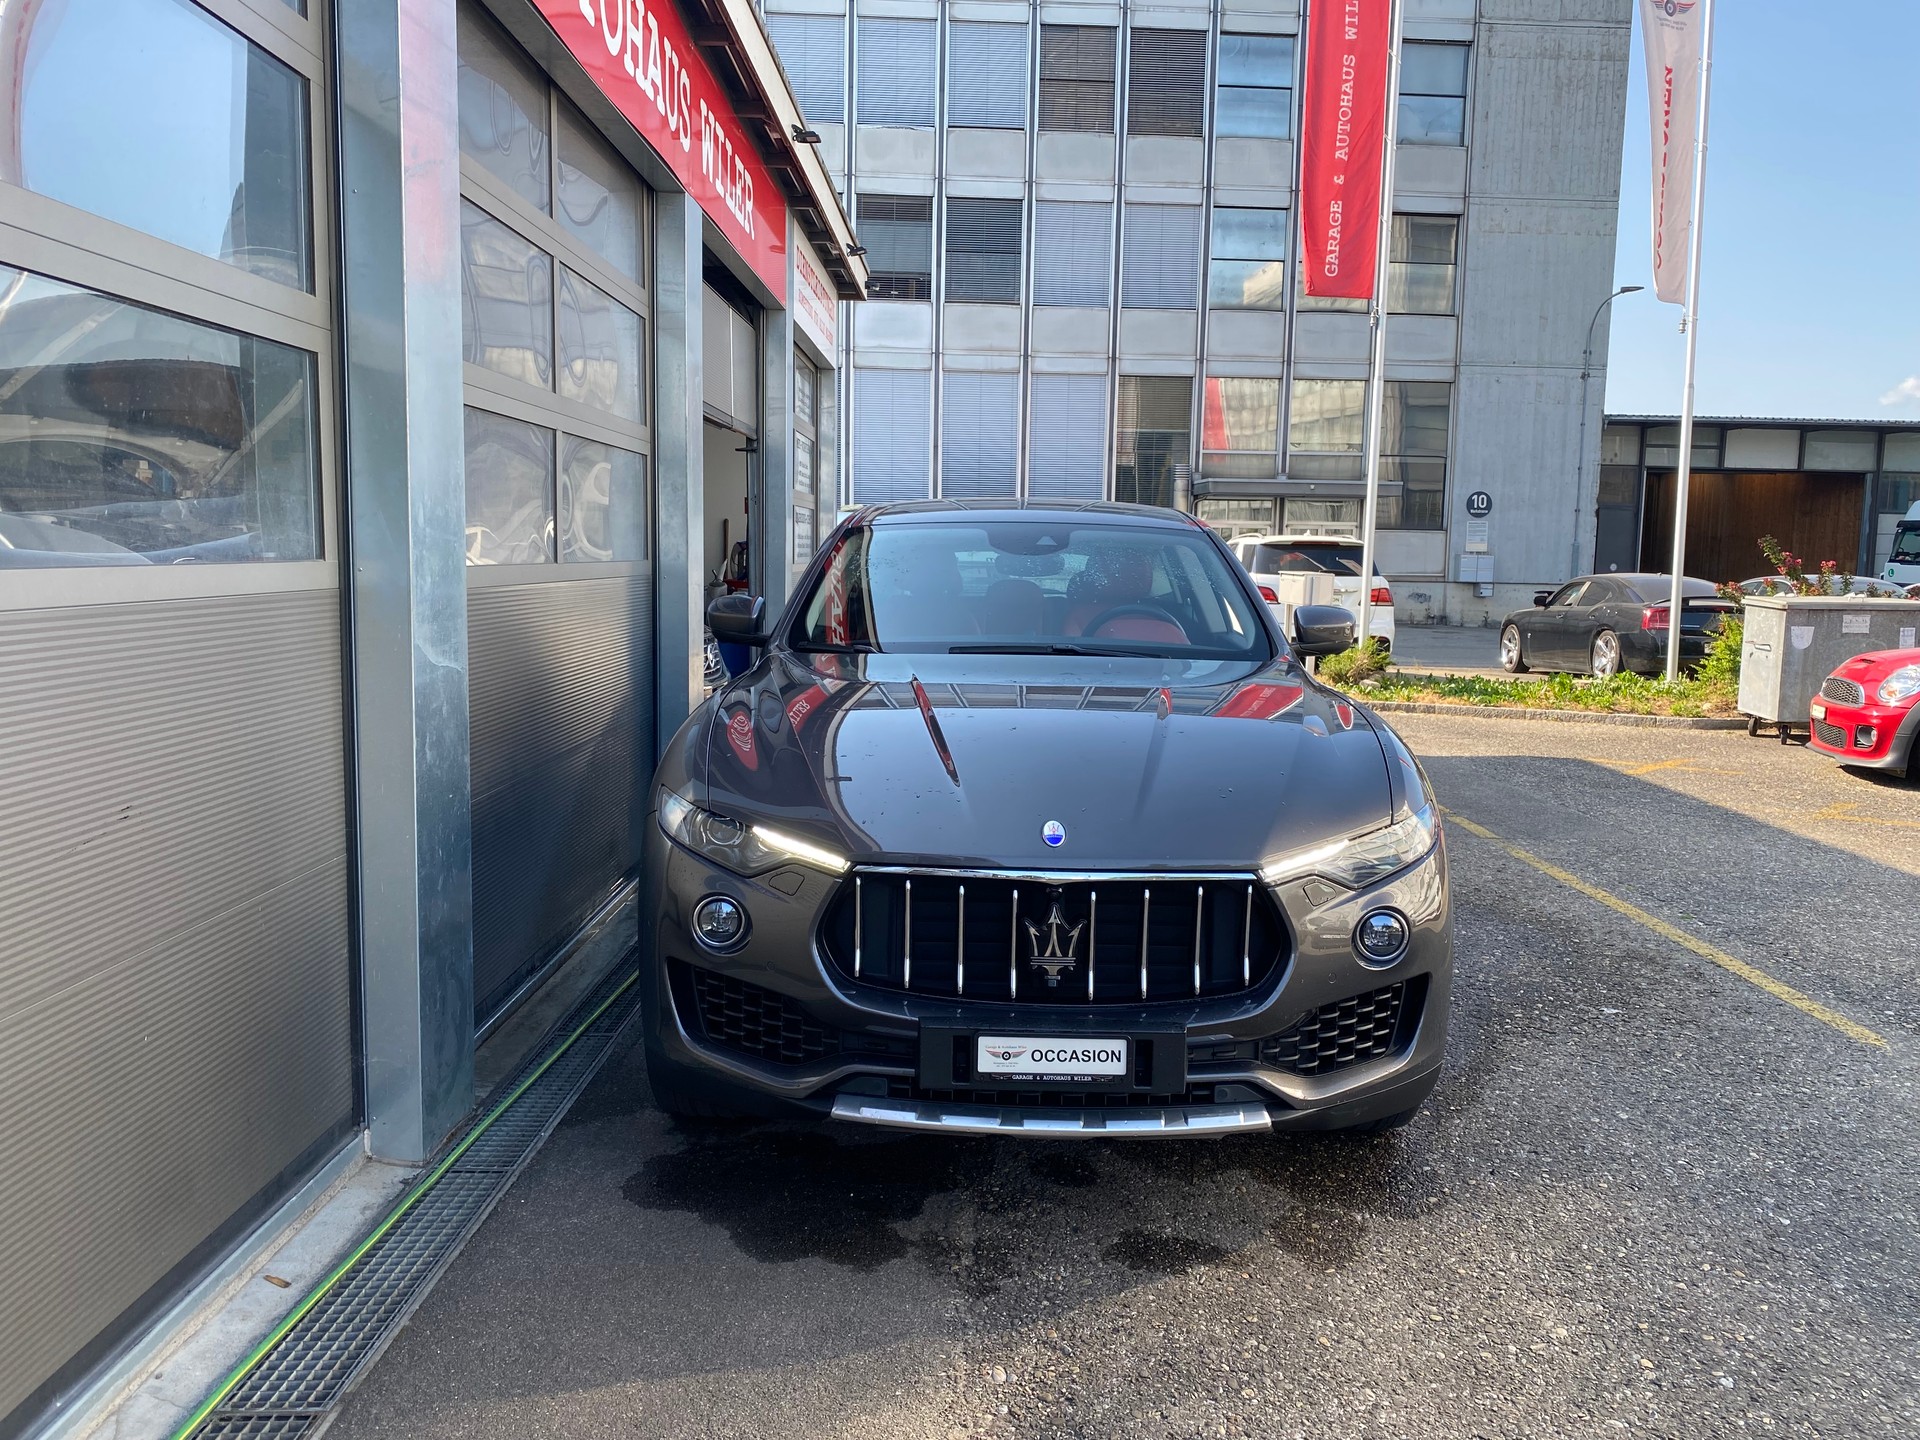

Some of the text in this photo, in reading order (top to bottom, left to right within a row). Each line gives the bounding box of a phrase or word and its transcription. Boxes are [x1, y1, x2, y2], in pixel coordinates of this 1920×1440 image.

[579, 0, 755, 240] OHAUS WILER
[1335, 54, 1356, 161] AUTOHAUS
[1334, 174, 1345, 184] &
[1325, 200, 1343, 277] GARAGE
[1472, 494, 1487, 508] 10
[1031, 1049, 1122, 1062] OCCASION
